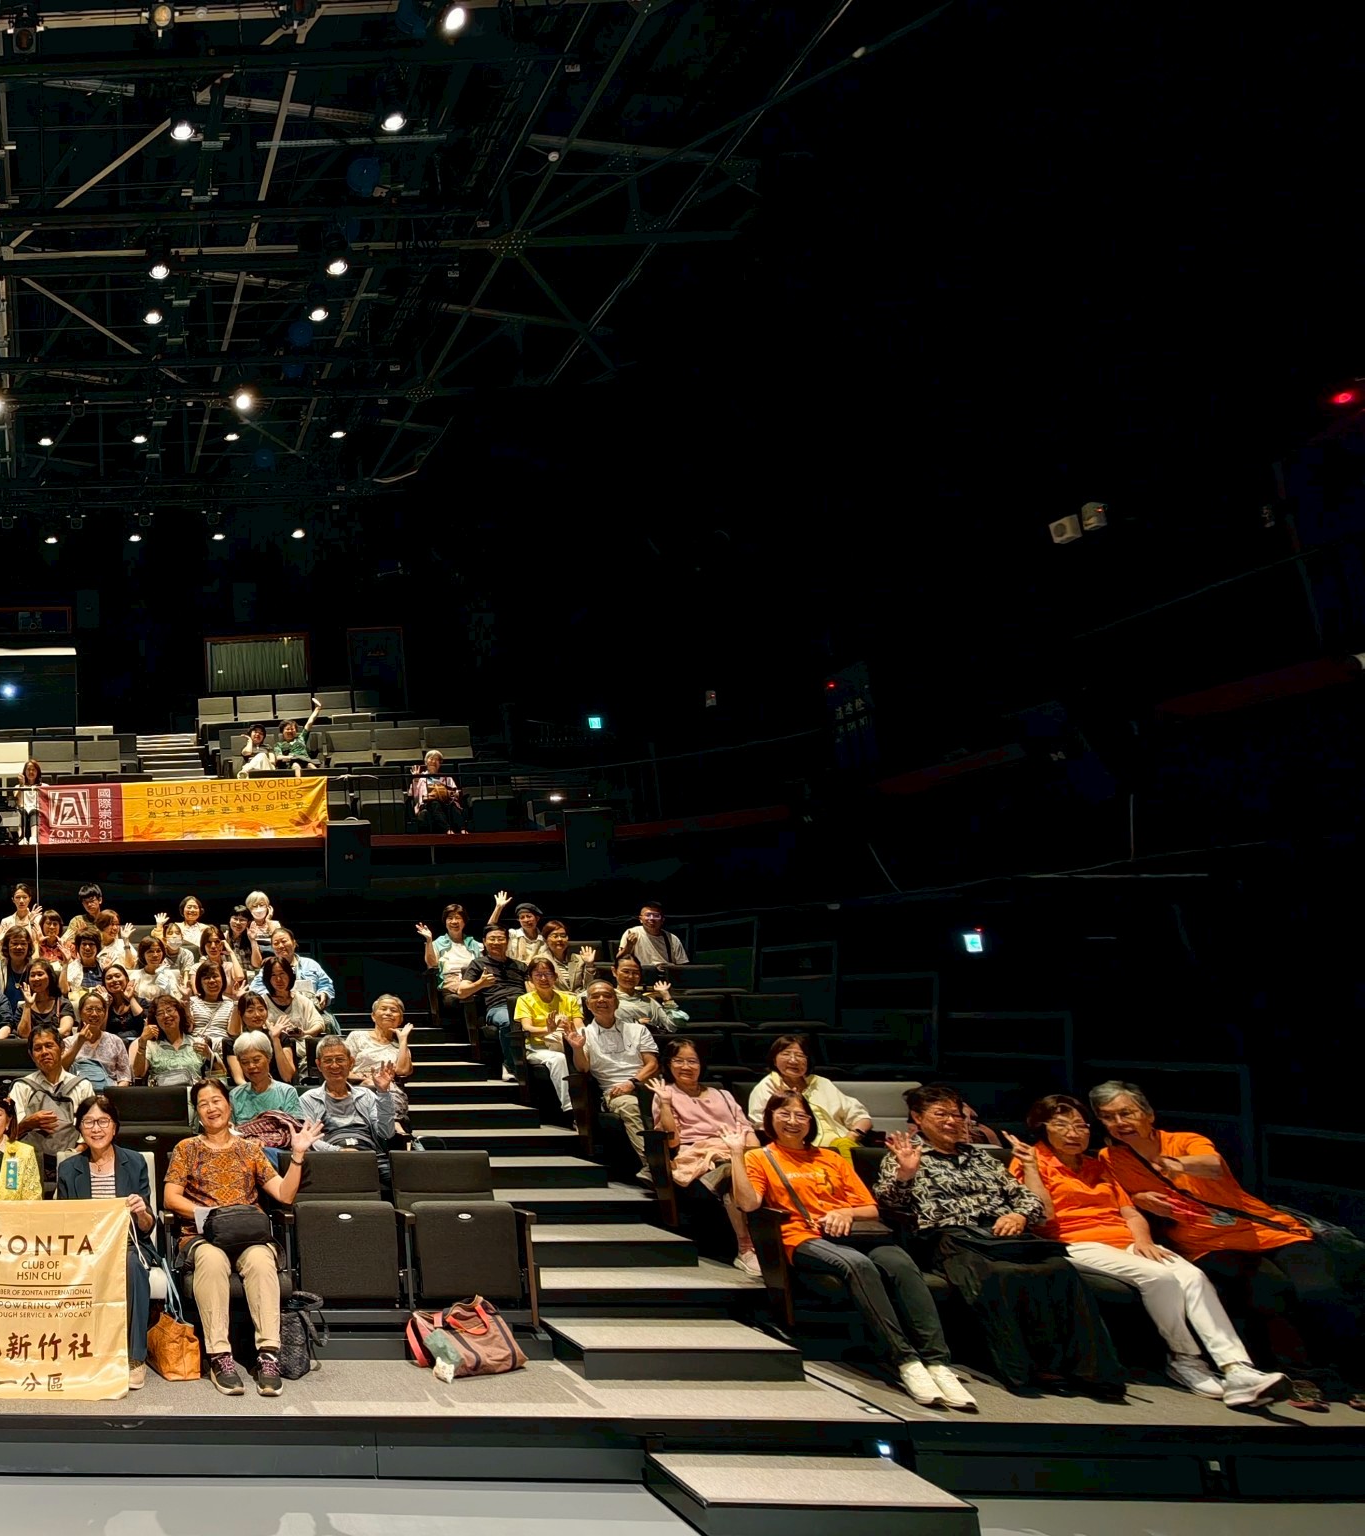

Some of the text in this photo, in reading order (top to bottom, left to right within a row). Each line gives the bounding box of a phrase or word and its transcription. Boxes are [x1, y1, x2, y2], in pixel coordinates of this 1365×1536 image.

[146, 778, 303, 797] BUILD A BETTER WORLD
[147, 790, 304, 809] FOR WOMEN AND GIRLS
[48, 829, 91, 839] ZONTA
[21, 1260, 60, 1270] CLUB OF
[16, 1271, 62, 1281] HSIN CHU
[43, 1288, 93, 1296] INTERNATIONAL
[54, 1300, 93, 1309] WOMEN
